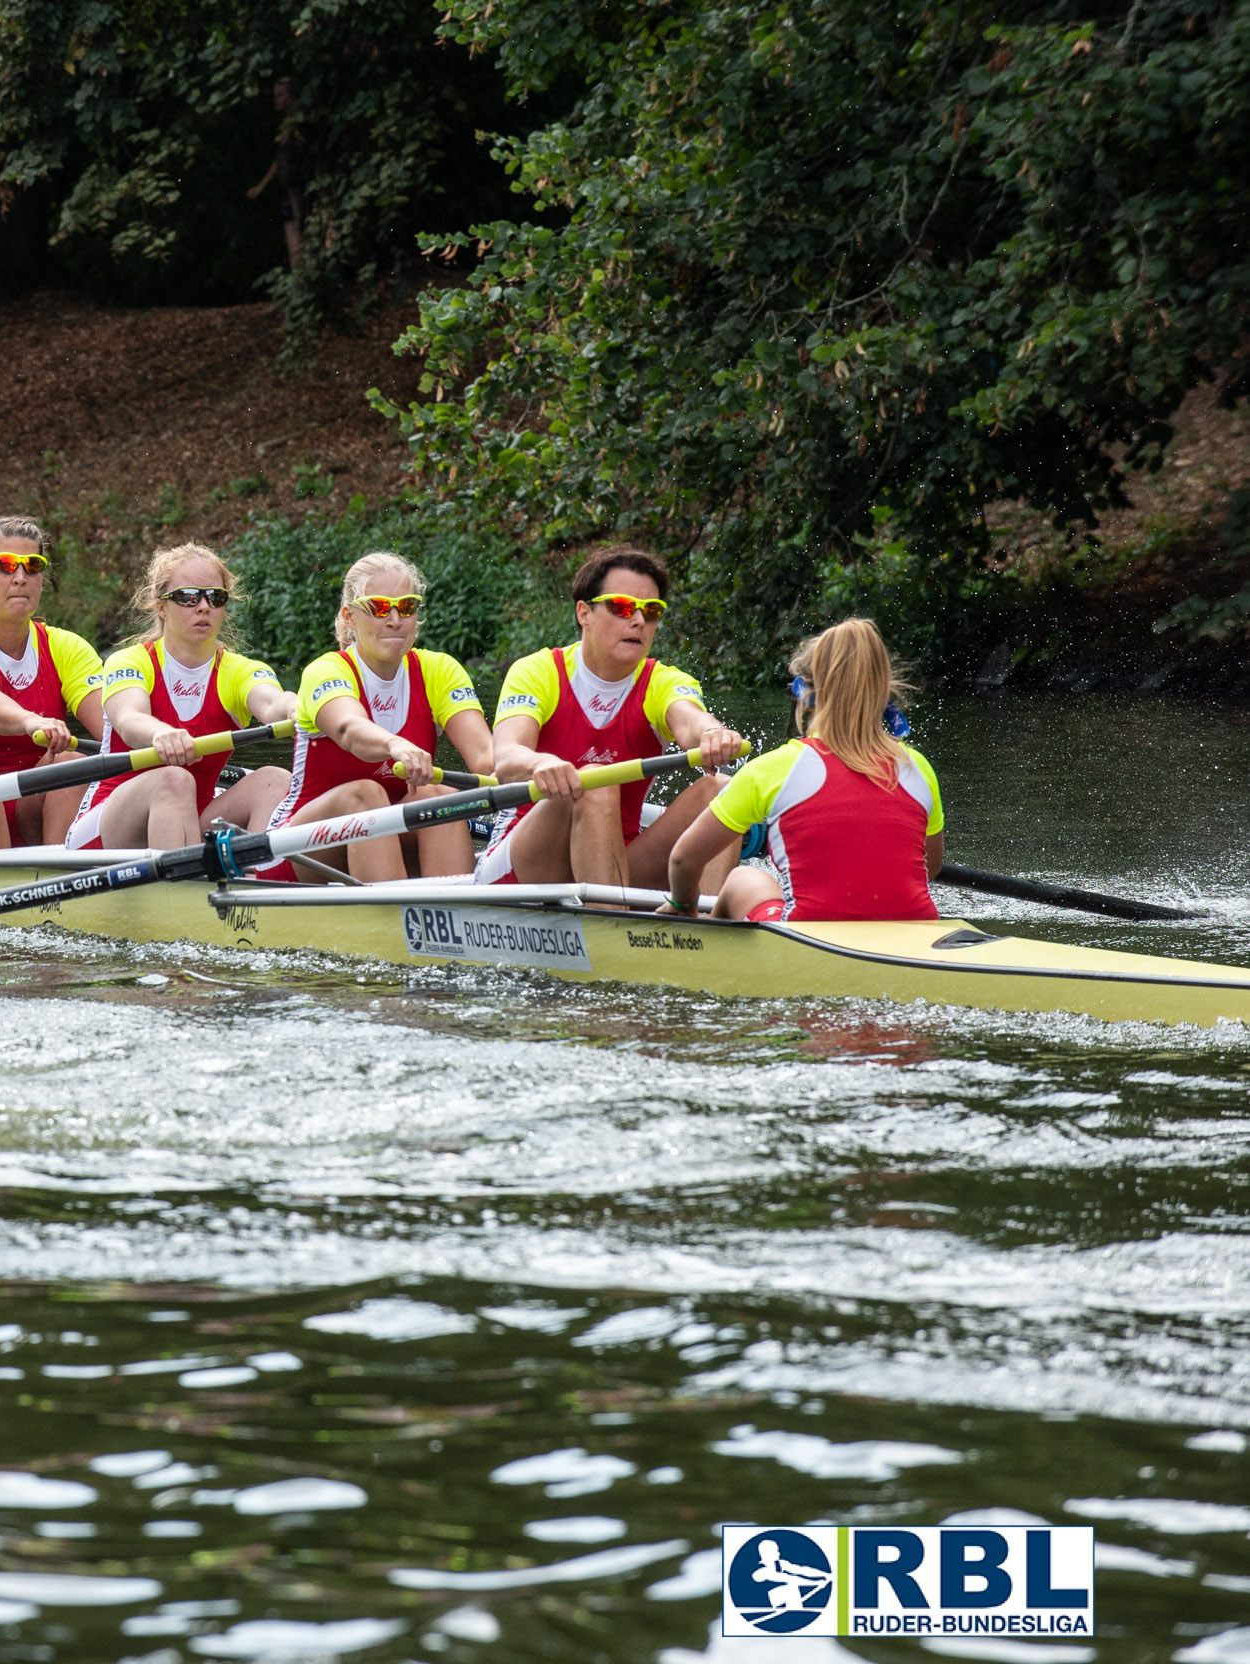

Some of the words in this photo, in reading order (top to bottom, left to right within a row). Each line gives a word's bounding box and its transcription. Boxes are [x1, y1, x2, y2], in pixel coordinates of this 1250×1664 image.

[115, 668, 144, 681] RBL
[323, 679, 352, 691] RBL
[508, 694, 537, 706] RBL
[305, 817, 375, 849] Melitta
[116, 866, 141, 880] RBL
[12, 882, 72, 904] SCHNELL.
[73, 875, 103, 890] GUT.
[421, 908, 463, 945] RBL
[463, 920, 586, 958] RUDER-BUNDESLIGA
[672, 932, 704, 951] Minden
